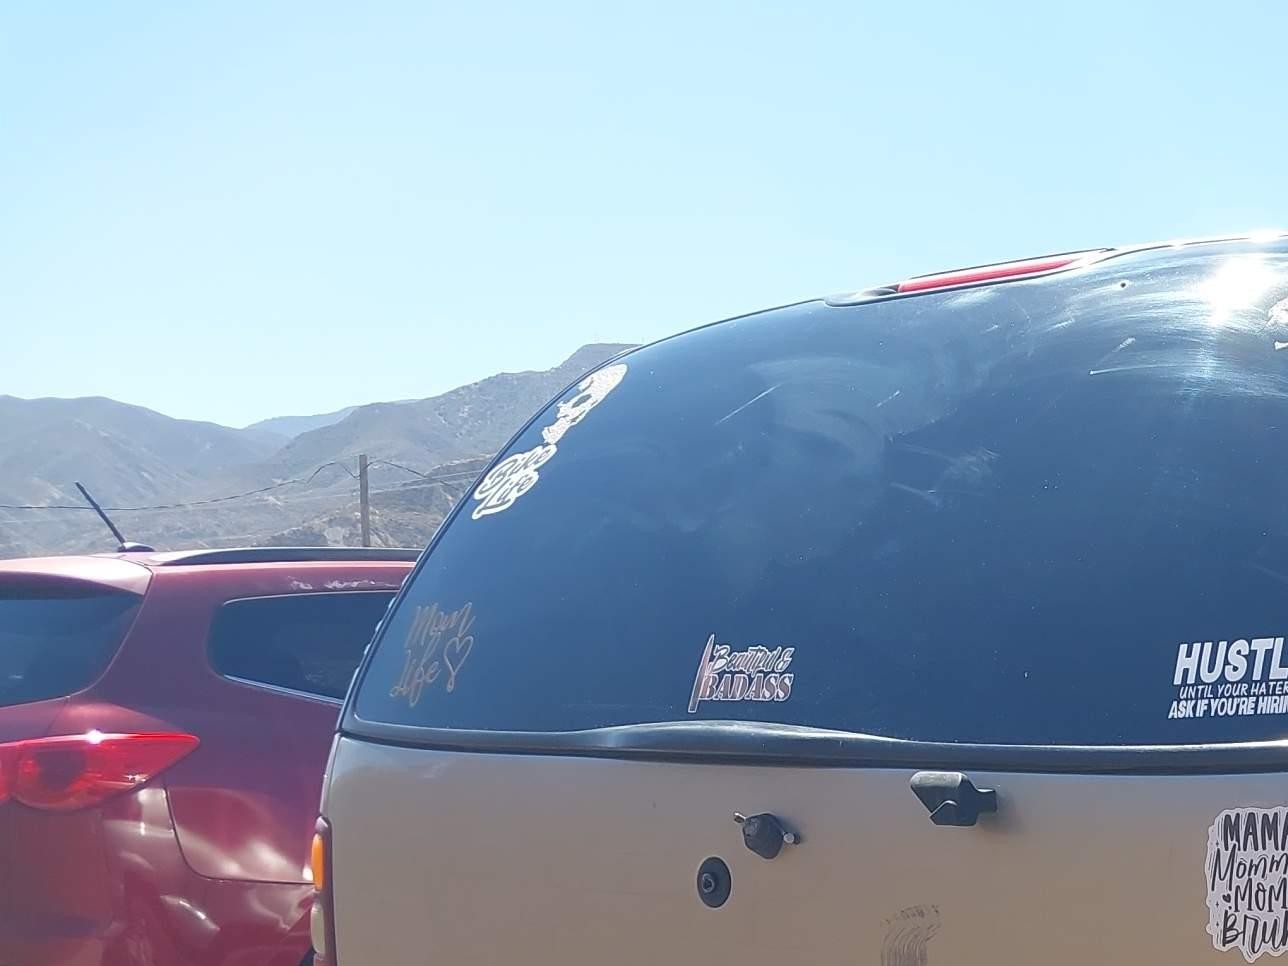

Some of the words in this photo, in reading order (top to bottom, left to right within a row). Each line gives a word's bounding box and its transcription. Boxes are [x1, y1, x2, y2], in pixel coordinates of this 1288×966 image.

[699, 673, 794, 701] BADASS
[1179, 685, 1214, 699] UNTIL
[1217, 682, 1249, 697] YOUR
[1168, 699, 1197, 719] ASK
[1195, 698, 1209, 717] IF
[1210, 696, 1256, 717] YOU'RE
